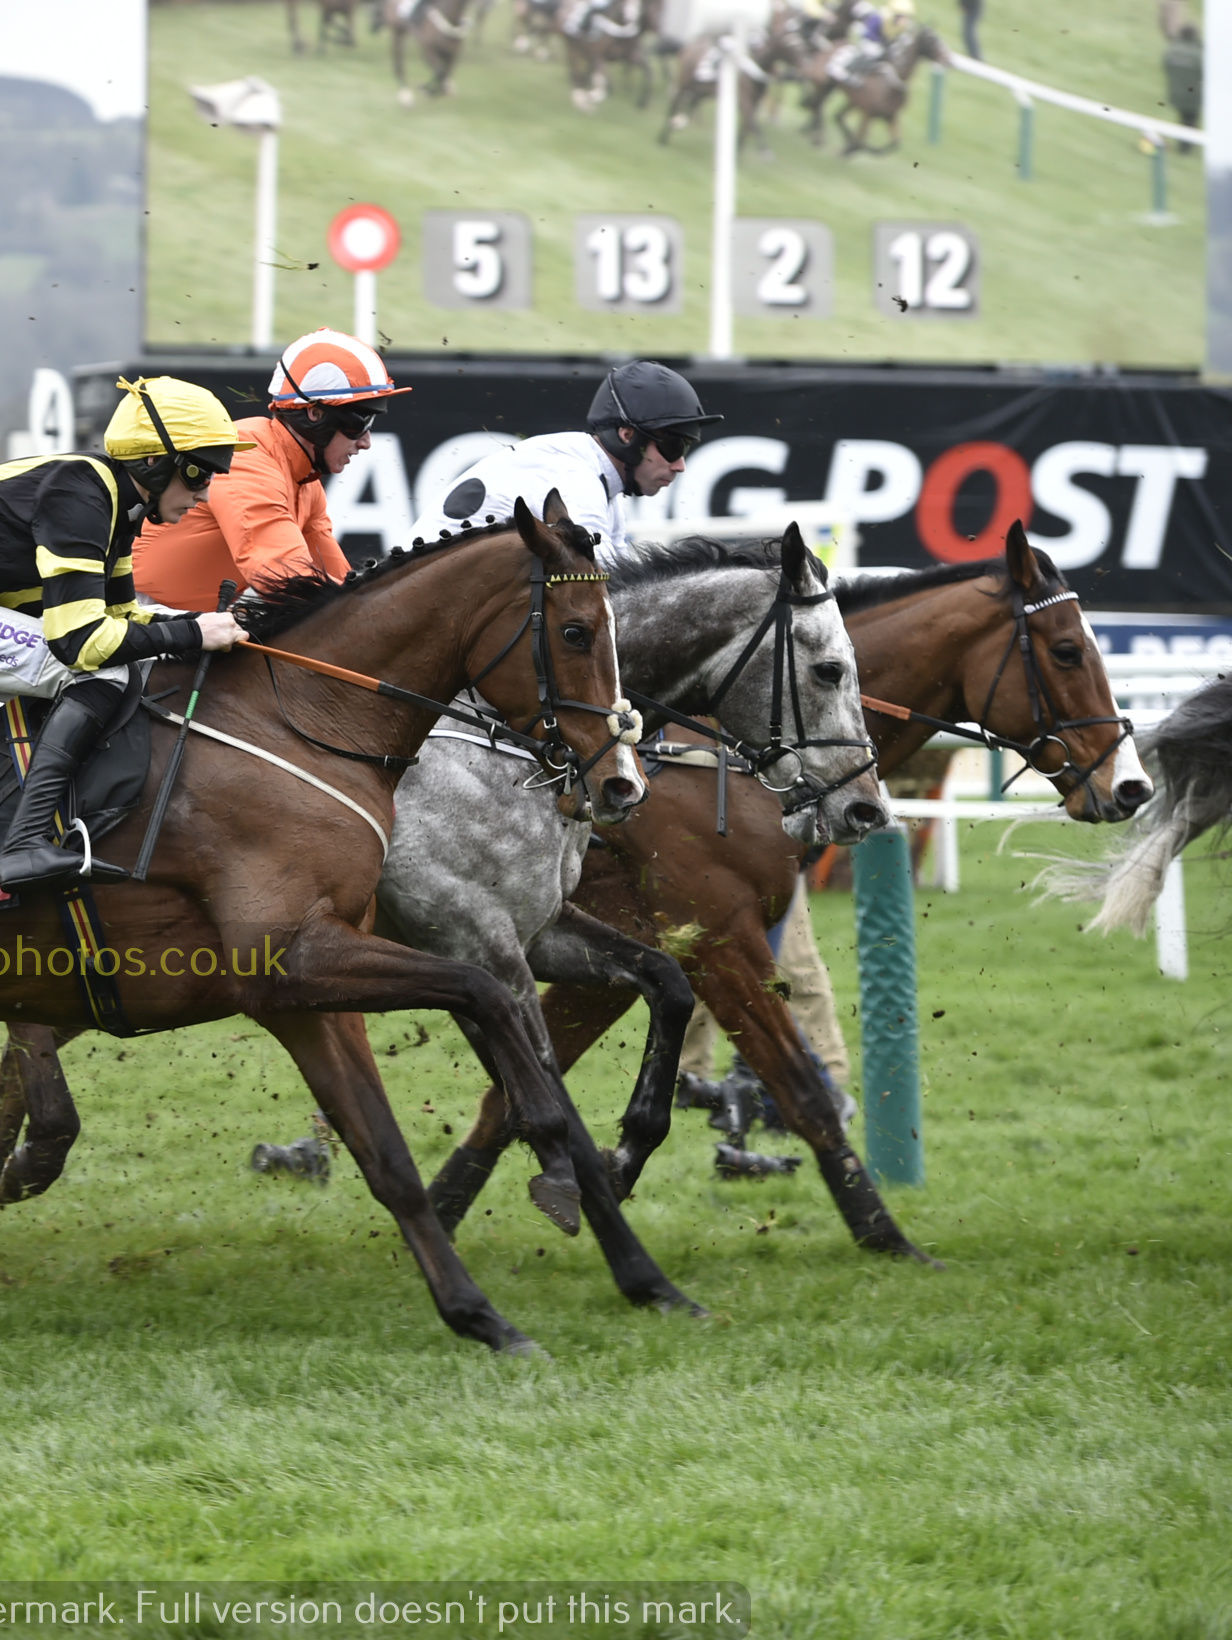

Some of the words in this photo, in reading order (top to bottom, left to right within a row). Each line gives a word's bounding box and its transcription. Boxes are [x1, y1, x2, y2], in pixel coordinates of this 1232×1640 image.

[452, 221, 505, 299] 5
[587, 225, 670, 301] 13
[757, 229, 808, 304] 2
[889, 232, 970, 308] 12
[823, 439, 1209, 571] POST
